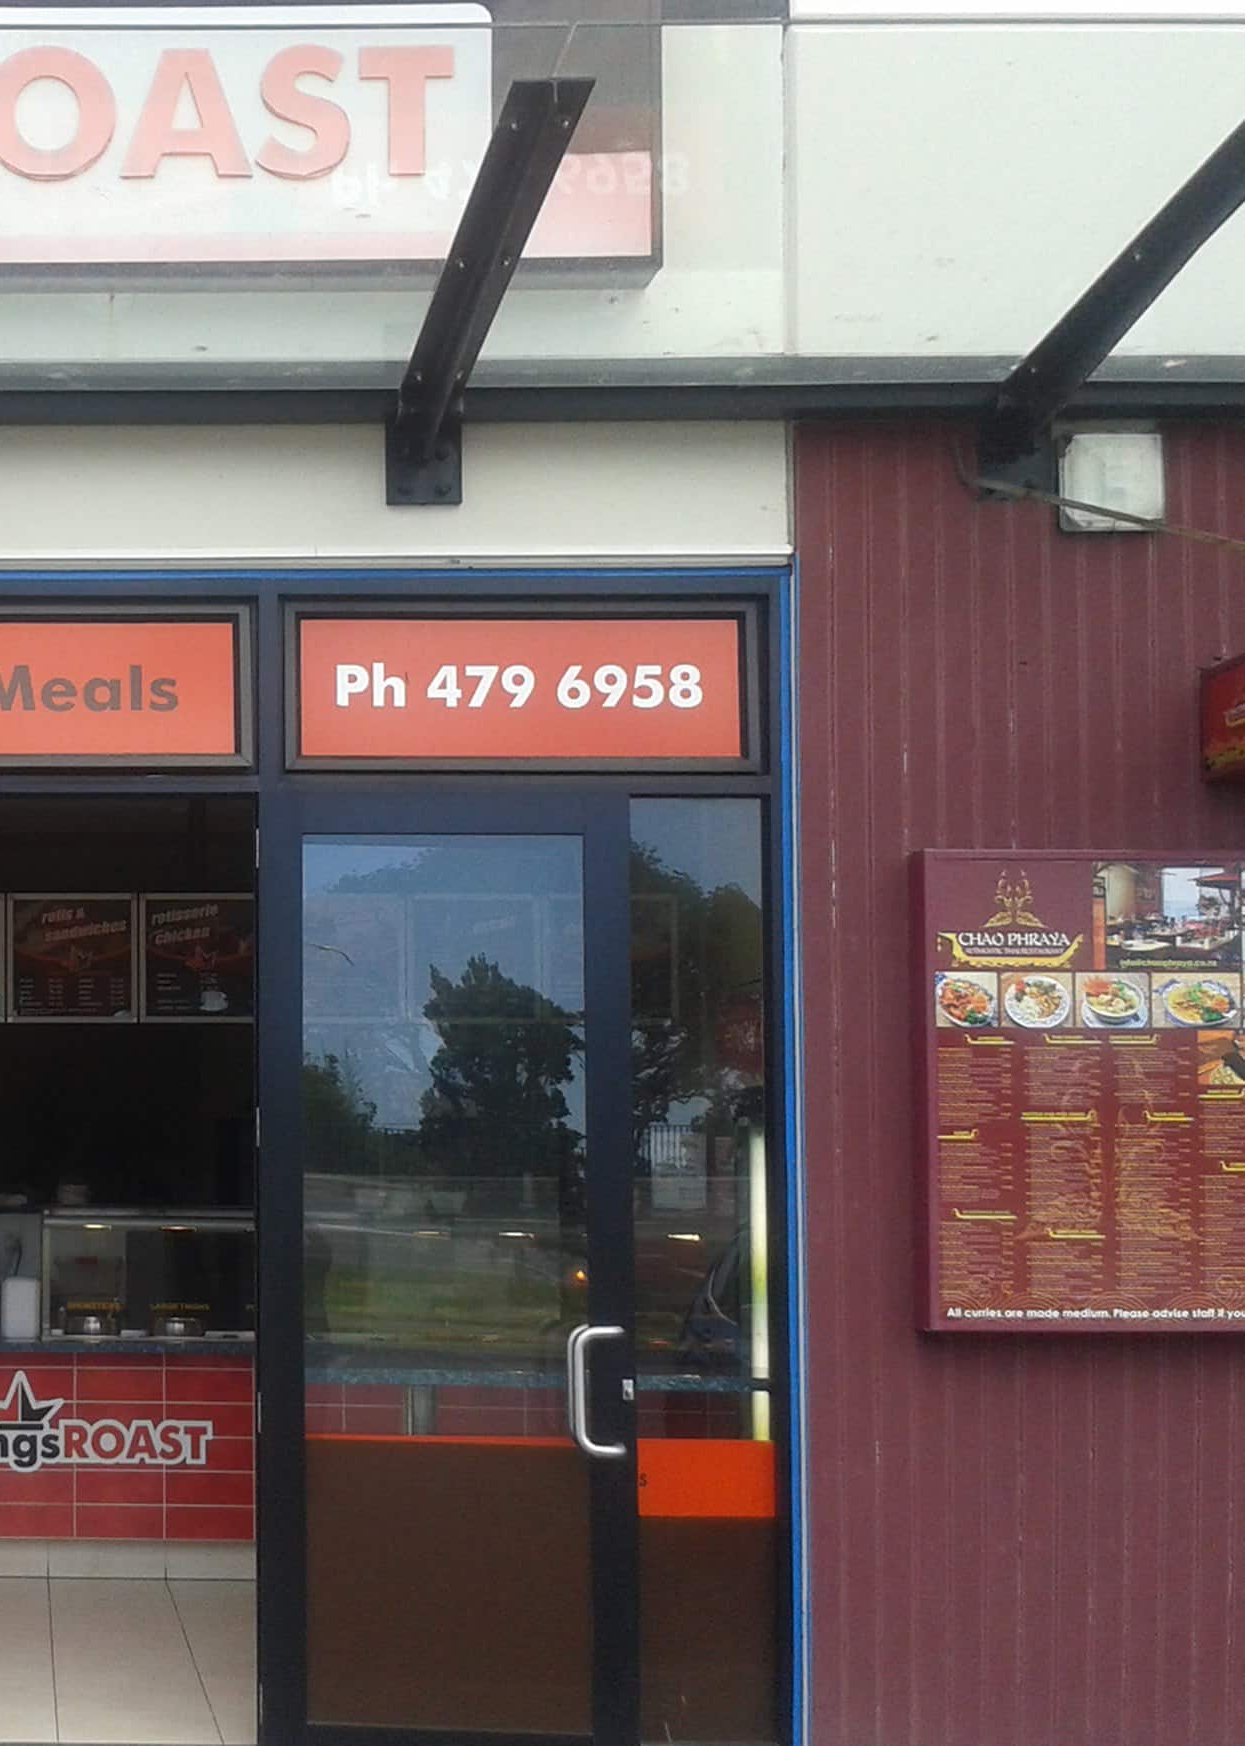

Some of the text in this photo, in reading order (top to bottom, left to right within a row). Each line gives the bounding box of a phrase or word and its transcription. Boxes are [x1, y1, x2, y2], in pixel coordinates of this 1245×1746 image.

[336, 662, 704, 709] Ph 479 6958
[958, 932, 1071, 946] CHAO PHRAYA
[946, 1307, 962, 1318] All
[963, 1307, 1002, 1318] curries
[1004, 1309, 1024, 1318] are
[1026, 1307, 1060, 1318] made
[1113, 1307, 1150, 1318] Please
[1152, 1307, 1189, 1318] advise
[1192, 1307, 1215, 1318] staff
[1217, 1307, 1225, 1318] if
